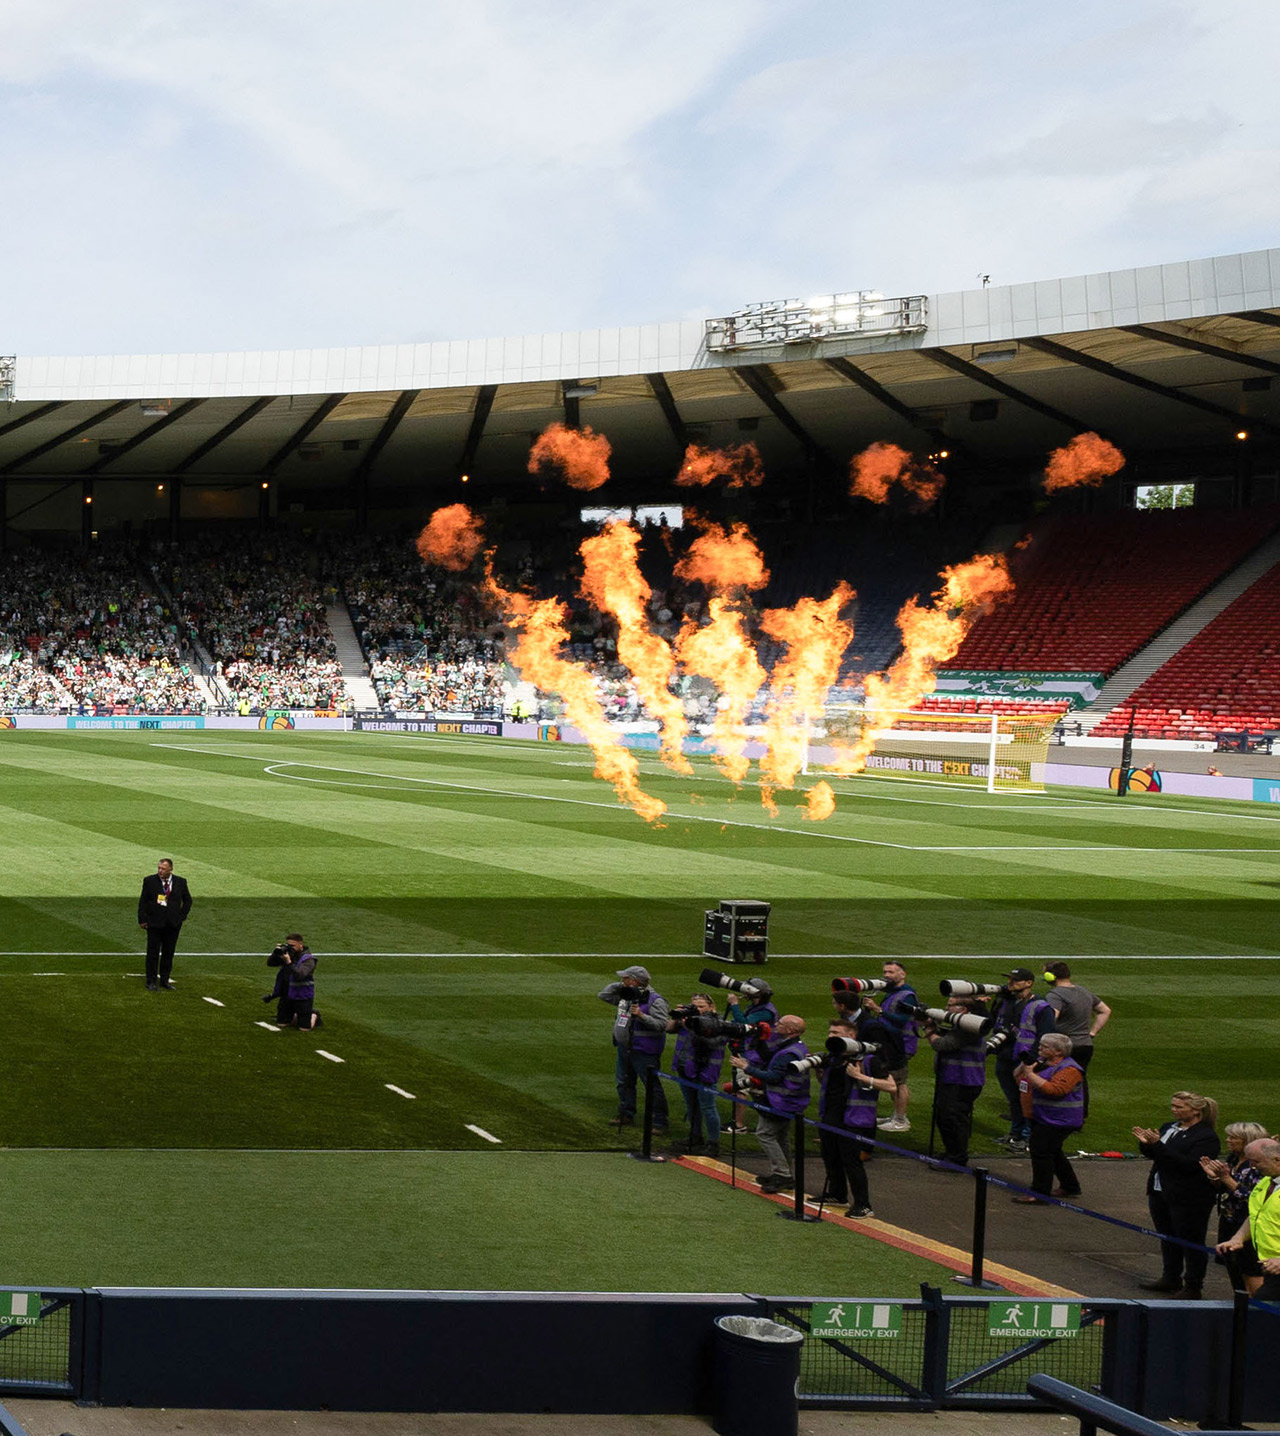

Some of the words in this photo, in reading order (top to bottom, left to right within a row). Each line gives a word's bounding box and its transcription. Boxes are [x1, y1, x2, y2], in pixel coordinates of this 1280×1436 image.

[75, 720, 113, 729] WELCOME
[114, 720, 124, 729] TO
[125, 720, 139, 729] THE
[140, 720, 160, 729] NEXT
[161, 720, 196, 729] CHAPTER
[362, 721, 405, 731] WELCOME
[406, 723, 418, 732] TO
[419, 723, 436, 733] THE
[437, 723, 461, 733] NEXT
[866, 755, 910, 770] WELCOME
[911, 759, 924, 772] TO
[925, 760, 943, 773] THE
[16, 1317, 38, 1325] EXIT
[813, 1328, 875, 1338] EMERGENCY
[876, 1329, 899, 1338] EXIT
[990, 1328, 1053, 1338] EMERGENCY
[1055, 1328, 1078, 1338] EXIT
